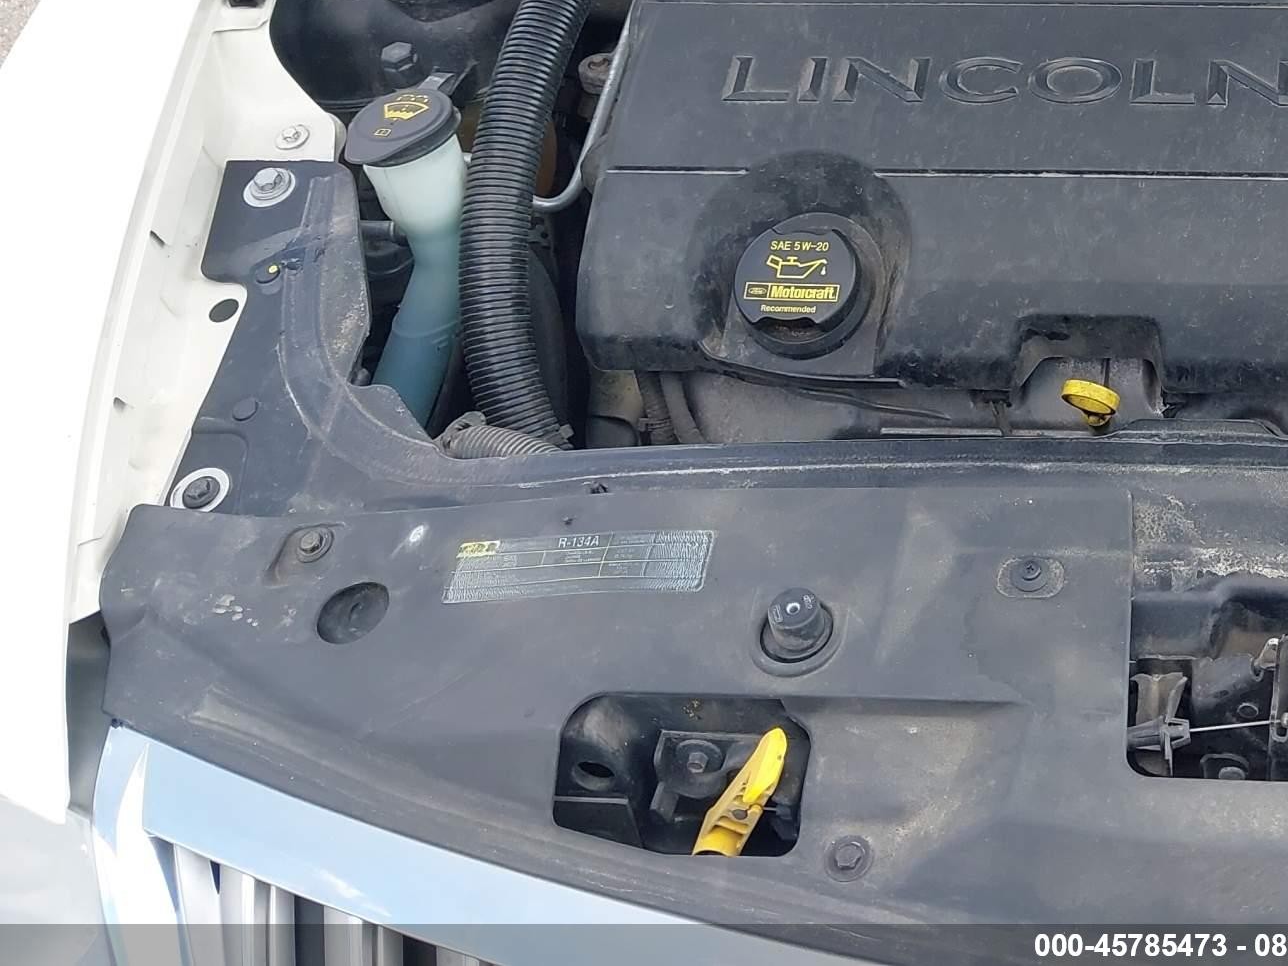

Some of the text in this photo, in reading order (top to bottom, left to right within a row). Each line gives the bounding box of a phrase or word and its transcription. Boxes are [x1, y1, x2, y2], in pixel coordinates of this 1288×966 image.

[770, 240, 792, 251] SAE
[770, 285, 836, 300] Motorcraft
[760, 304, 817, 314] Recommended
[557, 535, 600, 549] R-134A
